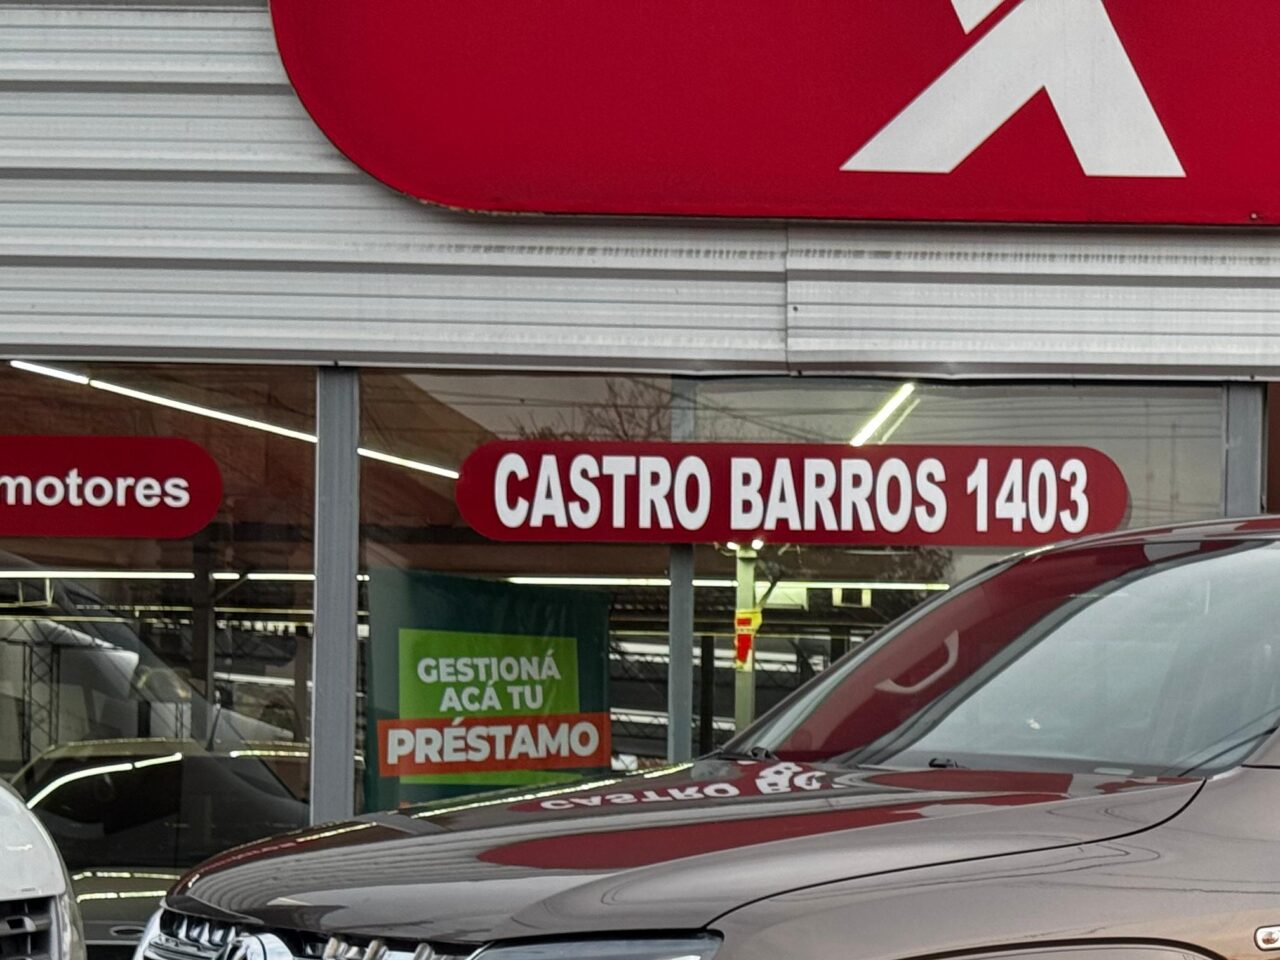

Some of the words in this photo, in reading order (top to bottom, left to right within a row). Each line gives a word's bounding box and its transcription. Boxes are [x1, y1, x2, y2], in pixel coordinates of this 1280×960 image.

[0, 467, 190, 508] motores
[495, 453, 712, 529] CASTRO
[729, 457, 948, 532] BARROS
[966, 458, 1090, 533] 1403
[416, 649, 562, 684] GESTIONÁ
[439, 680, 503, 713] ACÁ
[506, 685, 544, 710] TU
[386, 716, 600, 765] PRÉSTAMO
